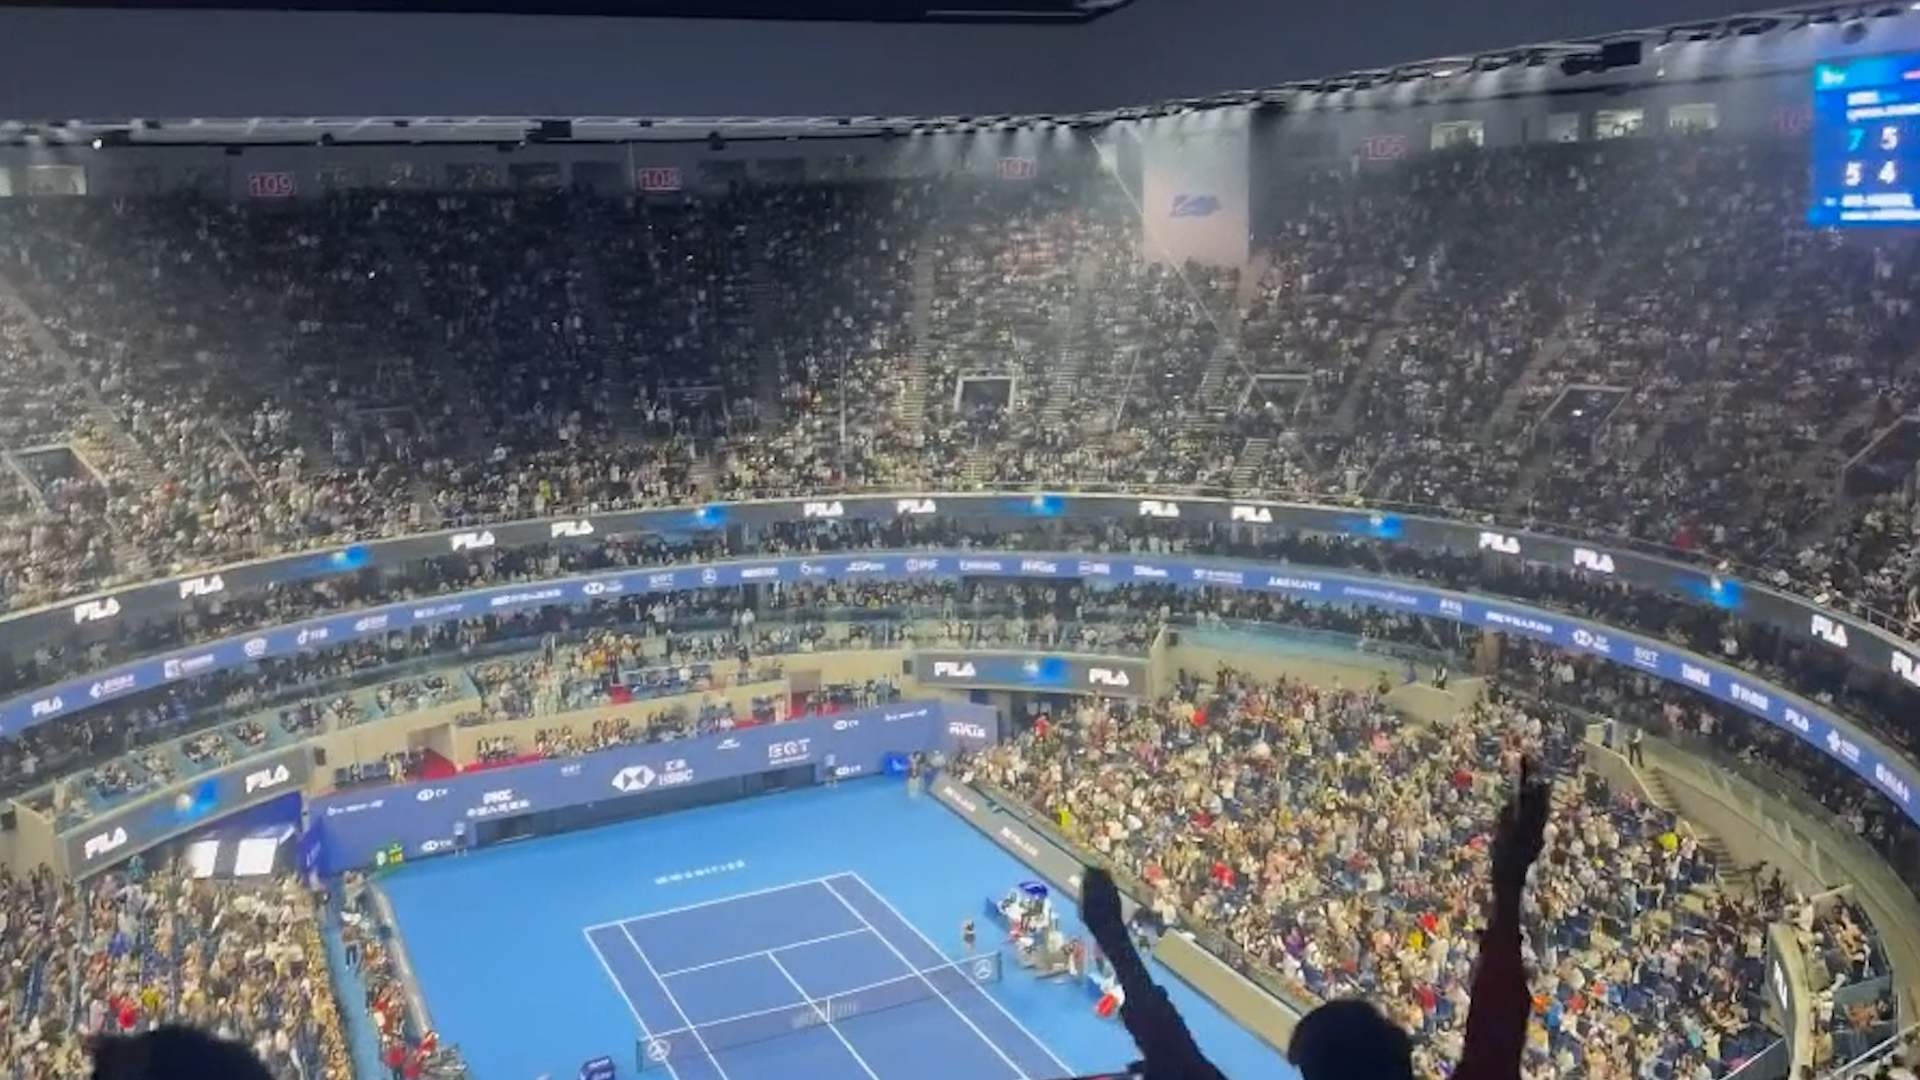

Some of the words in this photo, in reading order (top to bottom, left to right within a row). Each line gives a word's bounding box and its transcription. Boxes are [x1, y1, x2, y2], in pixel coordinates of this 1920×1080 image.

[1848, 128, 1864, 151] 7
[1881, 126, 1898, 150] 5
[250, 173, 294, 195] 109
[1845, 161, 1862, 187] 5
[1877, 160, 1896, 184] 4
[804, 500, 844, 517] FILA
[896, 499, 937, 515] FILA
[1138, 500, 1179, 517] FILA
[1232, 505, 1274, 523] FILA
[551, 519, 594, 538] FILA
[451, 530, 495, 551] FILA
[1479, 532, 1520, 554] FILA
[1573, 548, 1615, 574] FILA
[179, 575, 224, 599] FILA
[74, 598, 121, 624] FILA
[1811, 614, 1848, 648] FILA
[934, 661, 976, 678] FILA
[1088, 668, 1130, 687] FILA
[31, 696, 64, 718] FILA
[1785, 709, 1810, 733] FILA
[768, 739, 811, 759] EQT
[245, 764, 290, 793] FILA
[84, 826, 128, 860] FILA
